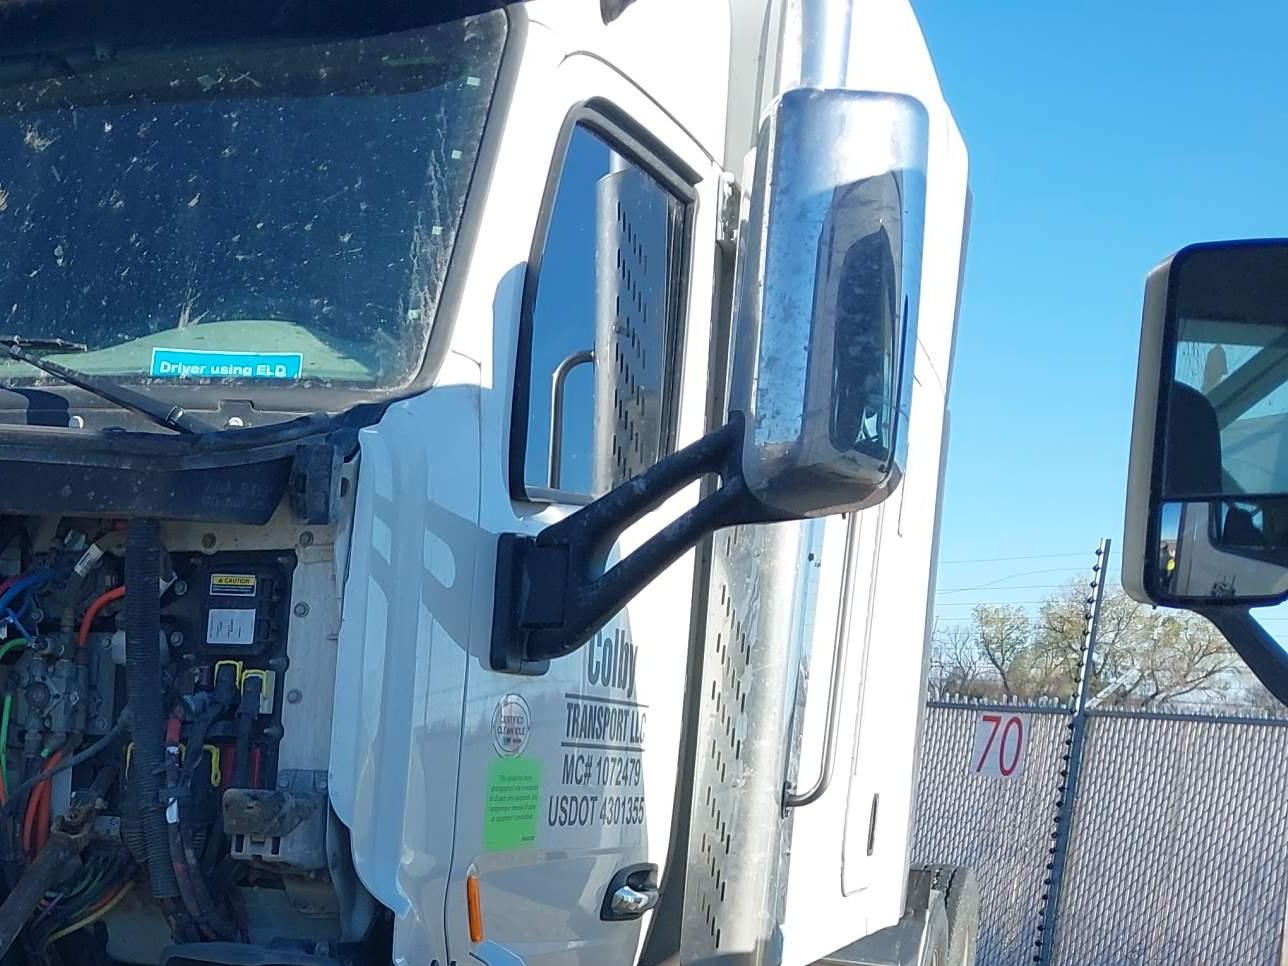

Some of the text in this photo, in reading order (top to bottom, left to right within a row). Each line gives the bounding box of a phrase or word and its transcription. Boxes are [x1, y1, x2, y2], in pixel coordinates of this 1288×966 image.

[160, 361, 287, 378] Driver using ELD
[587, 628, 638, 698] Colby
[565, 702, 647, 744] TRANSPORT LLC
[976, 714, 1023, 776] 70
[562, 754, 641, 787] MC# 1072479
[548, 795, 598, 827] USDOT
[599, 796, 644, 826] 4301355
